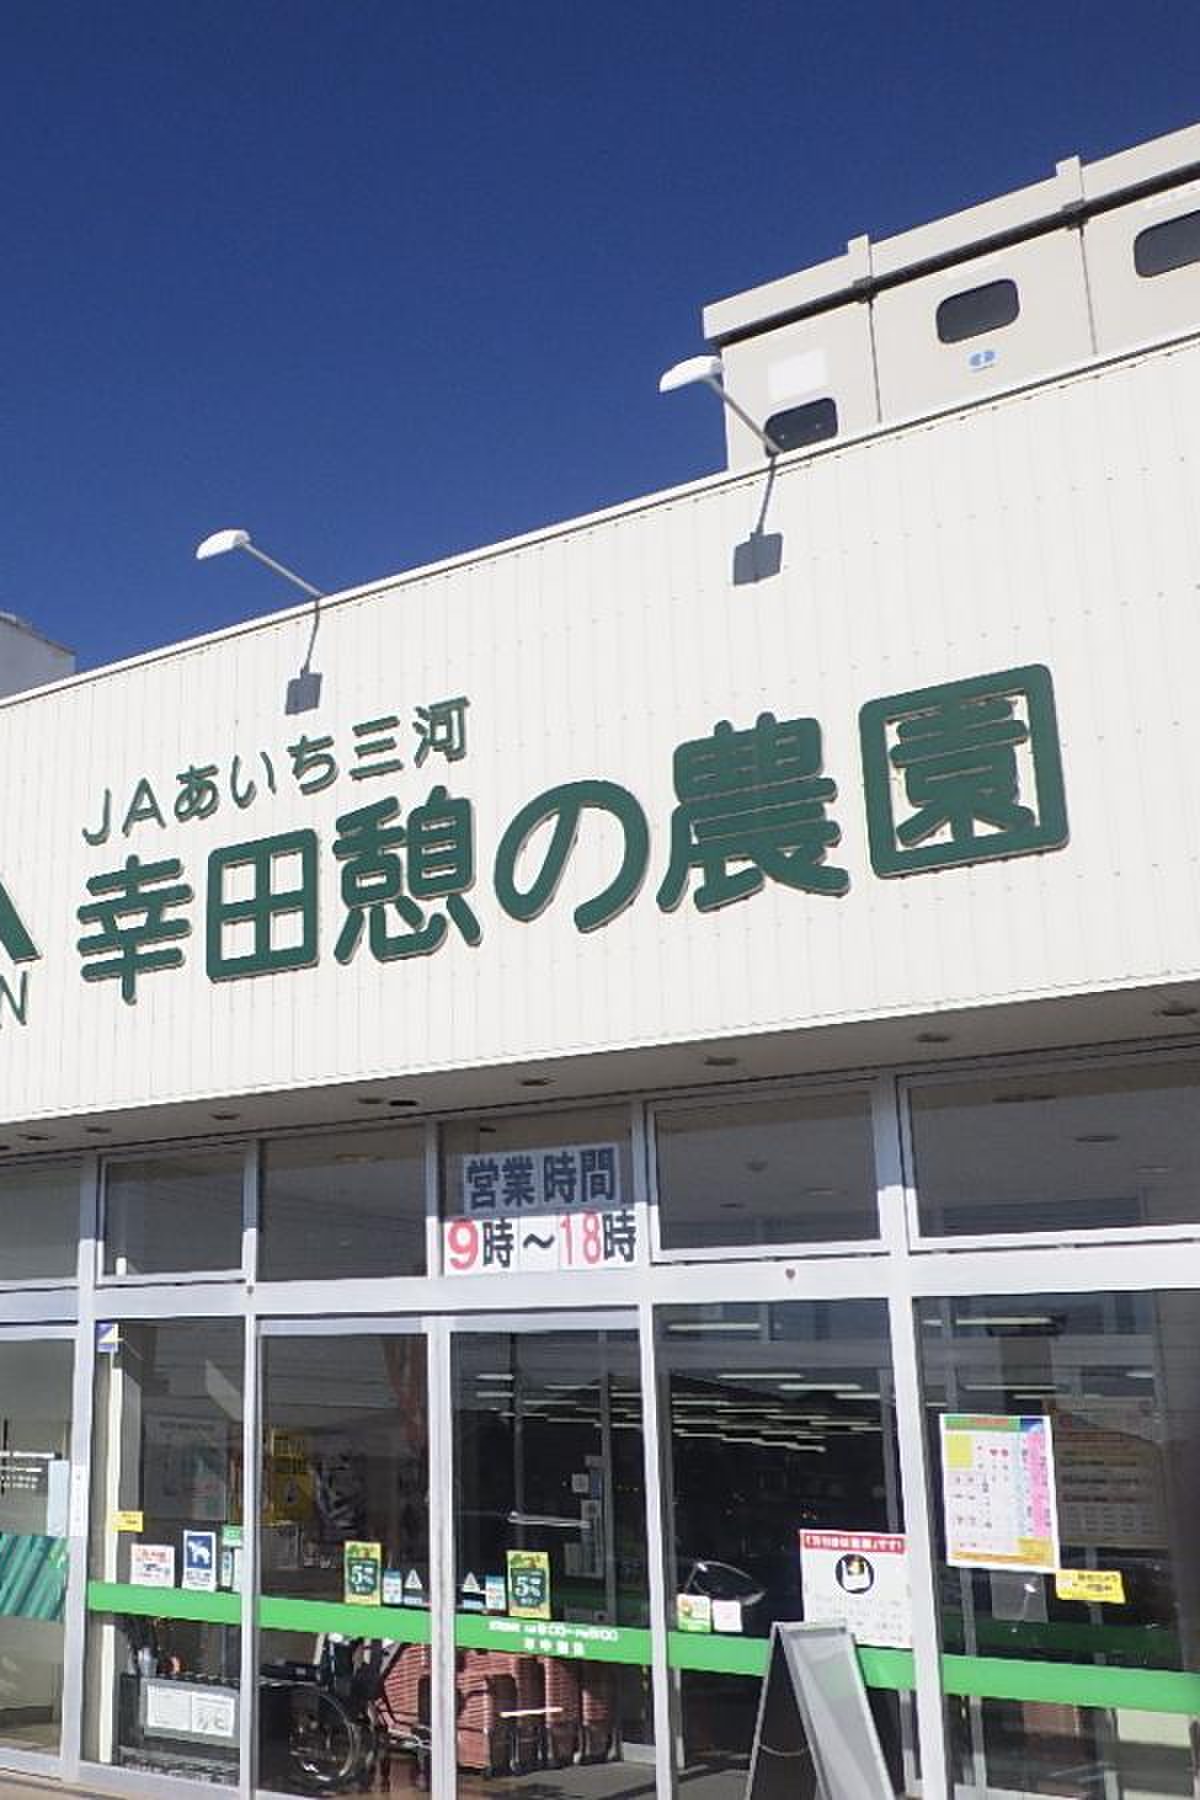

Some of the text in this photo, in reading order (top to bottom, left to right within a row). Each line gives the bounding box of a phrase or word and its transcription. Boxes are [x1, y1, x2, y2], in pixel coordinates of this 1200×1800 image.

[76, 663, 1069, 1004] 幸田憩の農園
[82, 696, 471, 847] JAあいち三河
[466, 1147, 615, 1210] 営業時間
